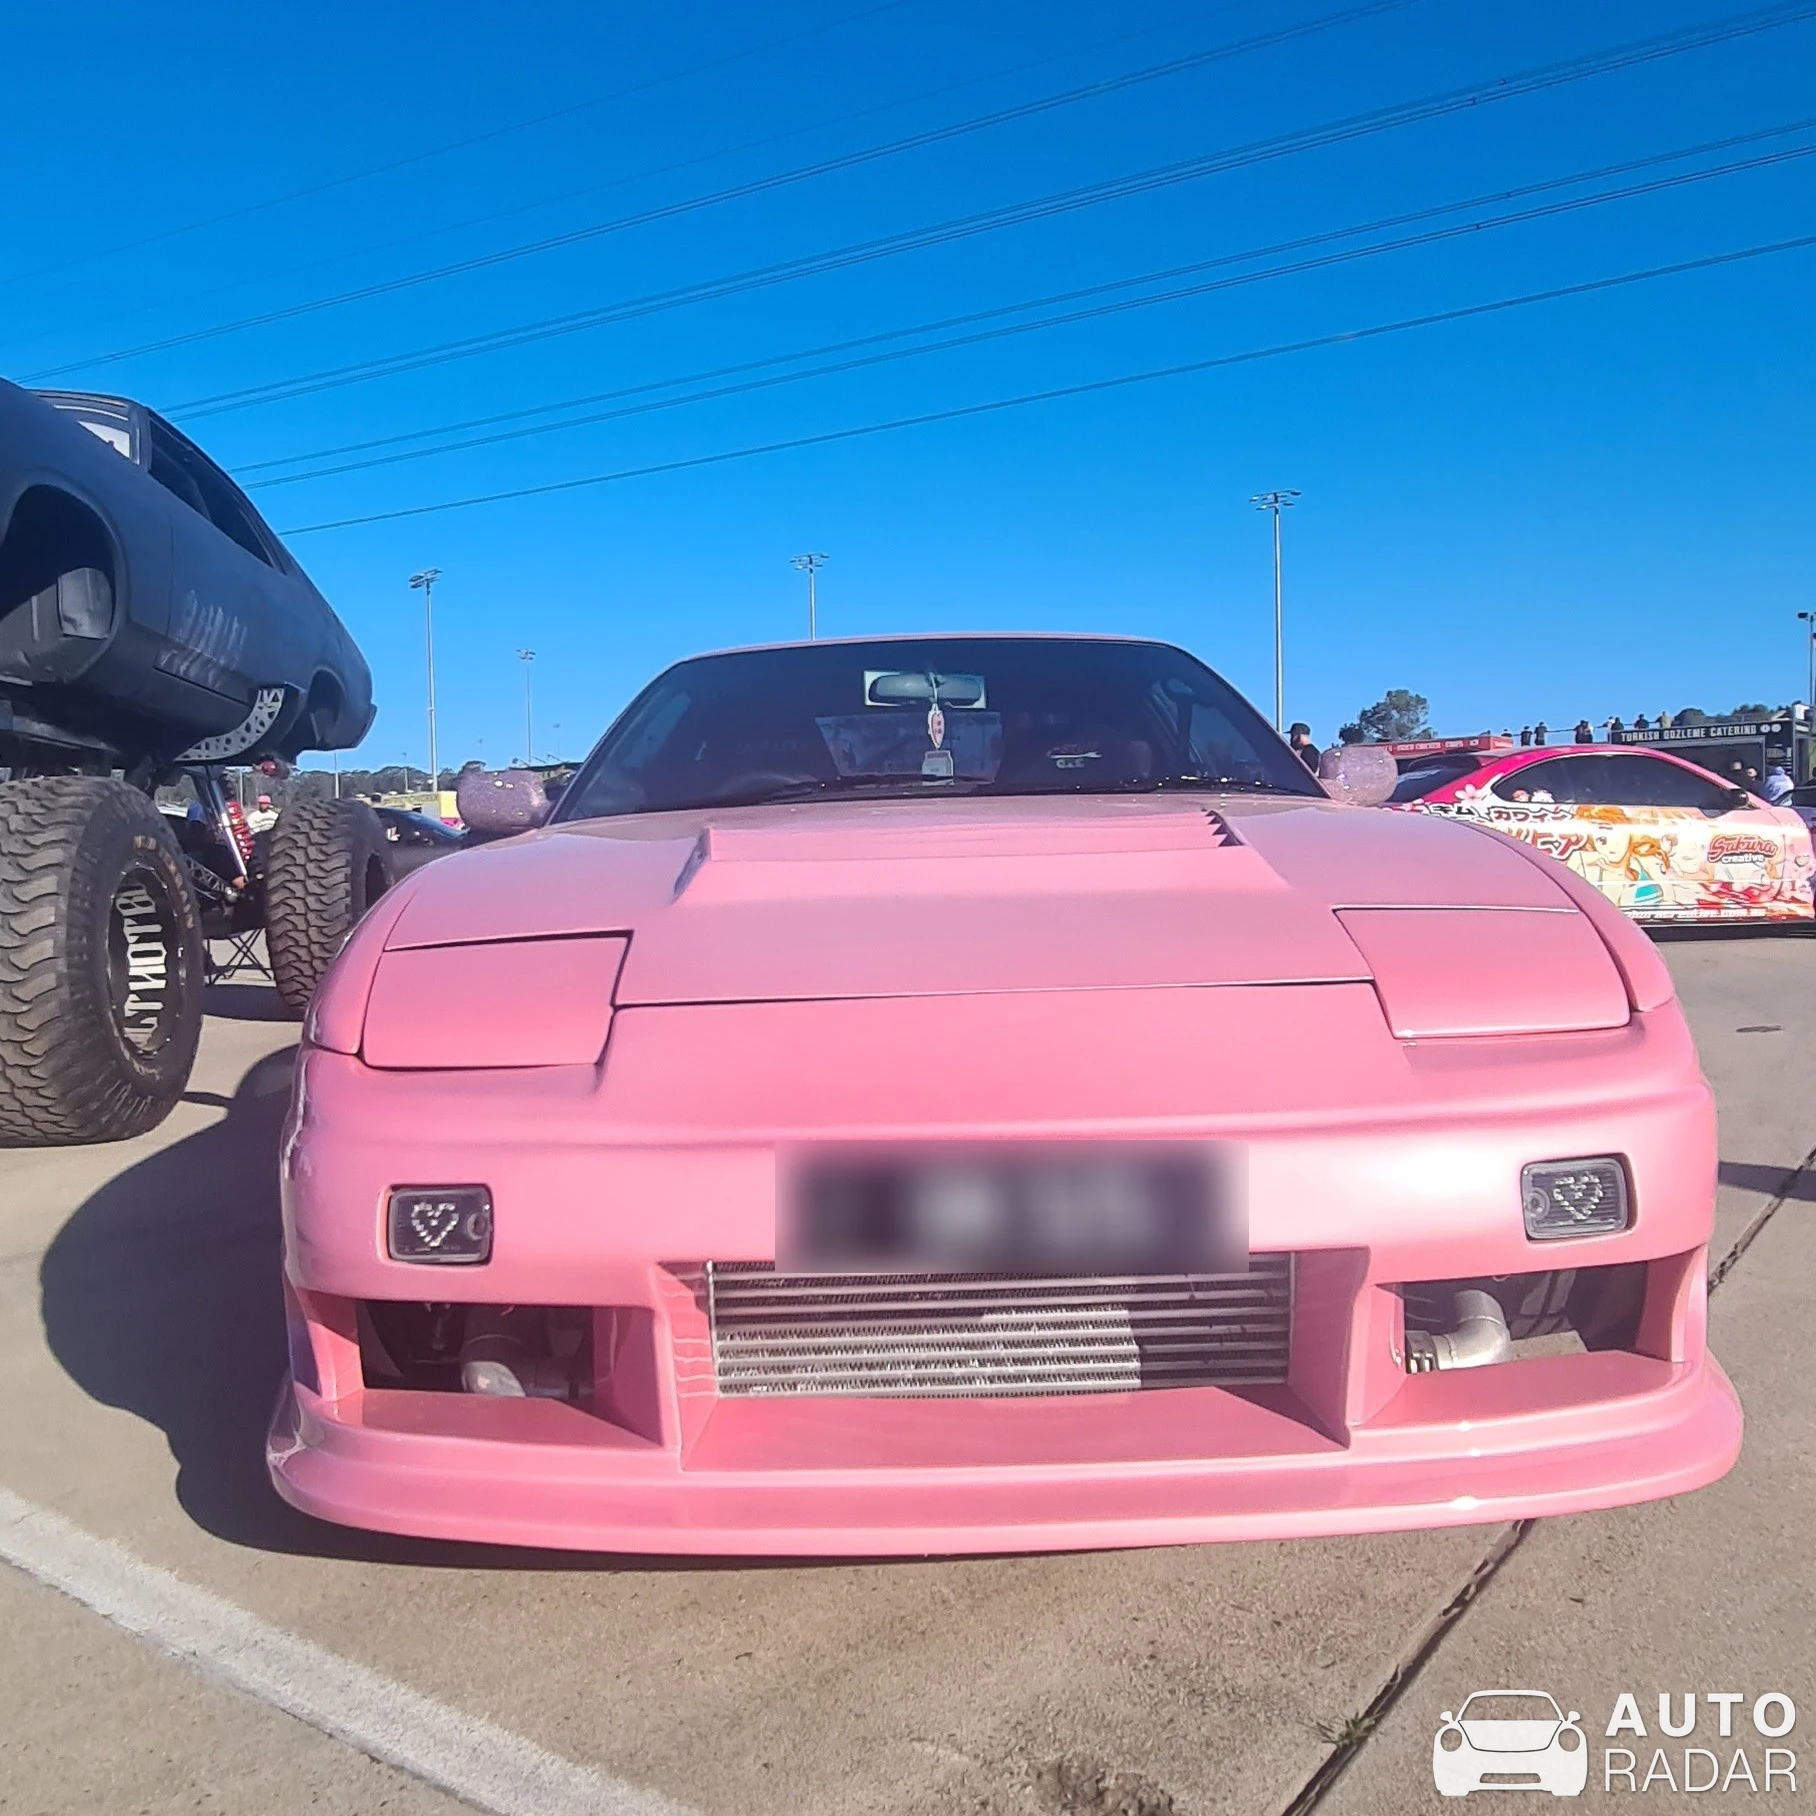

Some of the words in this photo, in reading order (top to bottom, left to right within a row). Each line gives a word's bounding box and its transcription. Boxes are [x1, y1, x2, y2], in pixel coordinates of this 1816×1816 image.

[1621, 730, 1660, 742] TURKISH
[1710, 724, 1757, 737] CATERING
[1708, 835, 1776, 861] Sakura
[1722, 853, 1765, 863] creative
